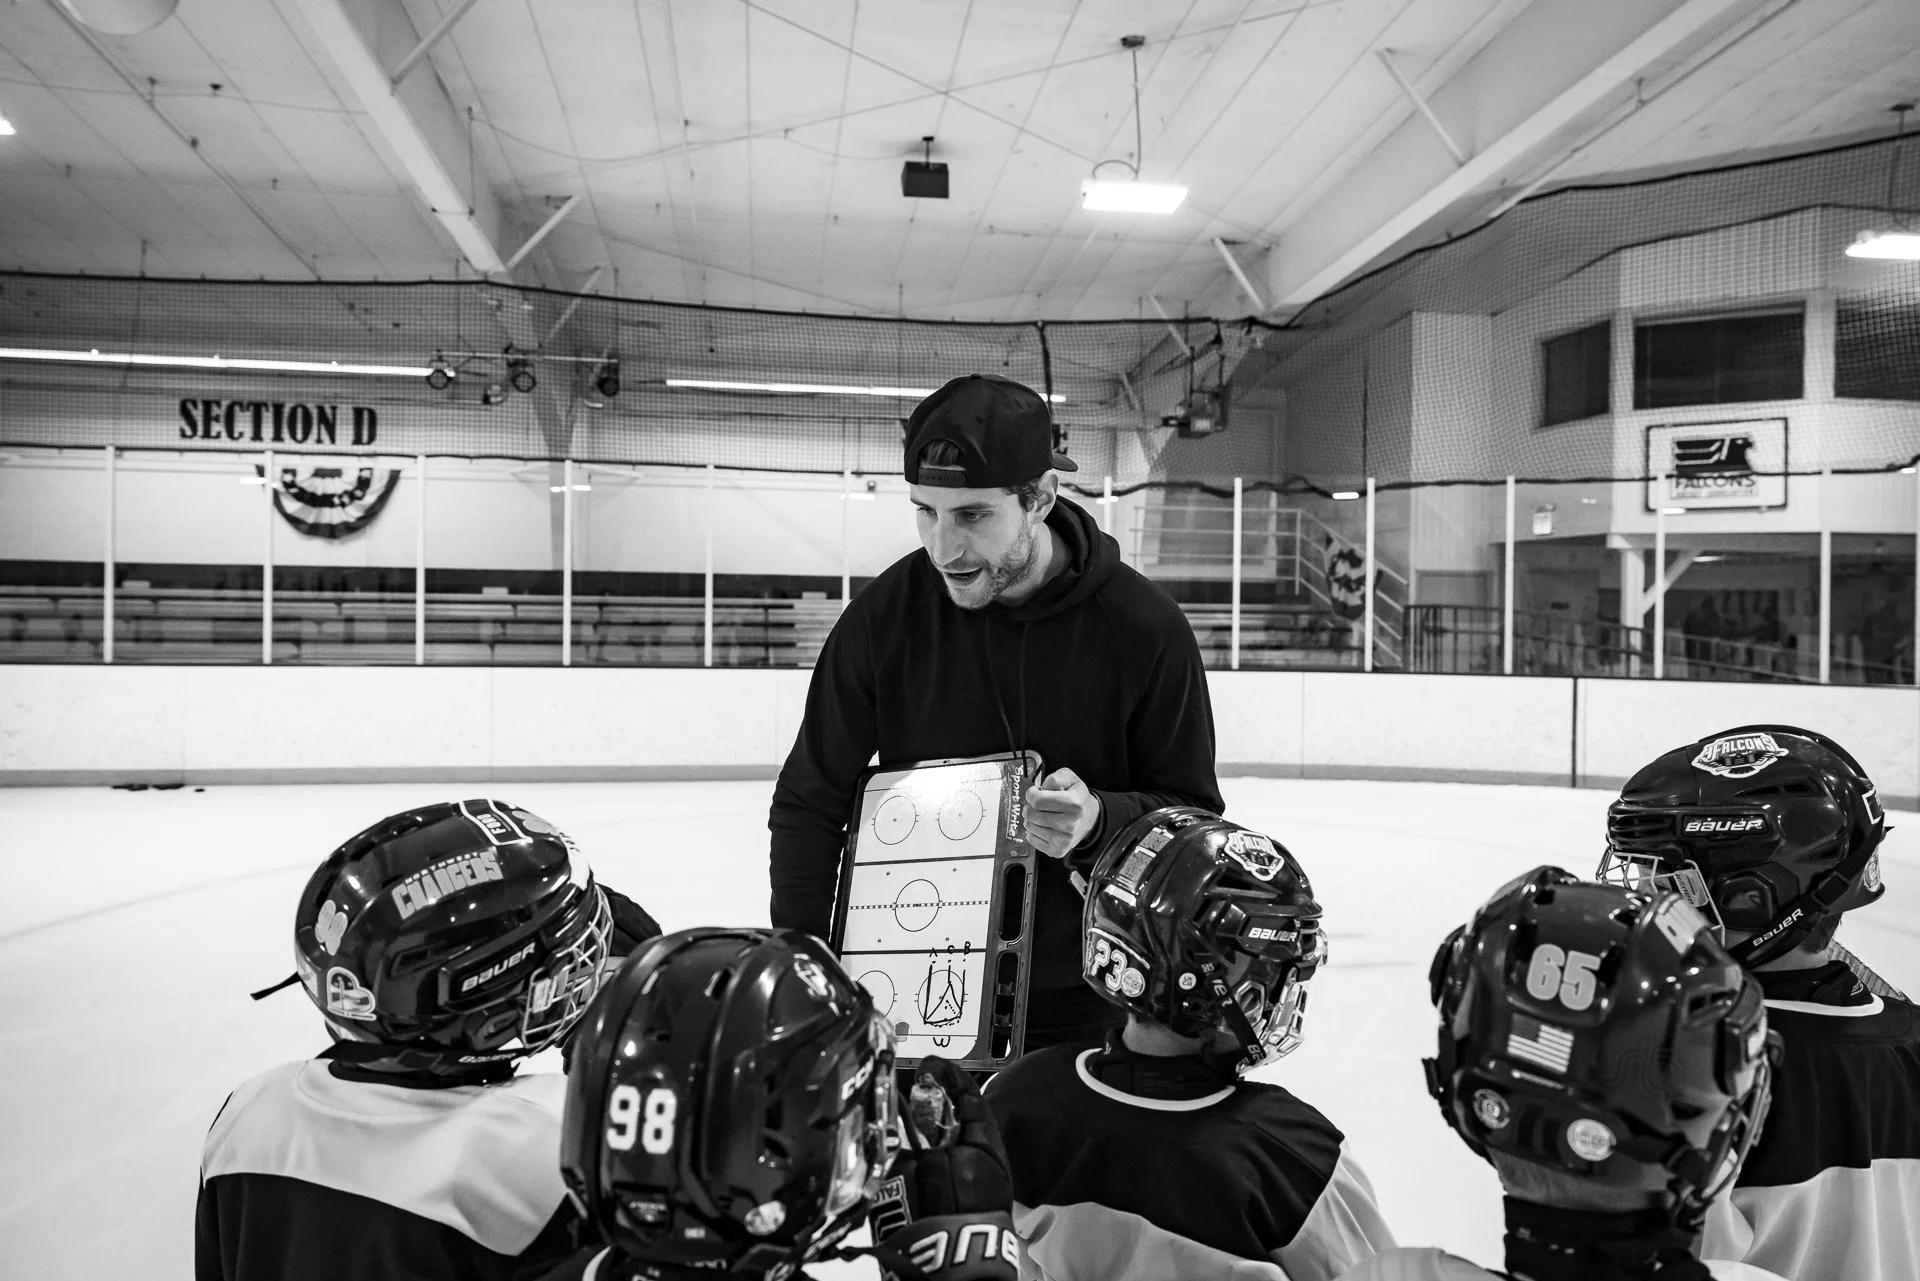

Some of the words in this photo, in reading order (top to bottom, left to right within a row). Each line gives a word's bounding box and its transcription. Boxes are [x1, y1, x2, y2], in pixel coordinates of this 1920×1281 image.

[180, 398, 337, 444] SECTION
[352, 407, 377, 446] D
[1012, 765, 1024, 802] Sport
[391, 850, 503, 920] CHARGERS
[1526, 943, 1601, 1011] 65
[606, 1084, 677, 1155] 98
